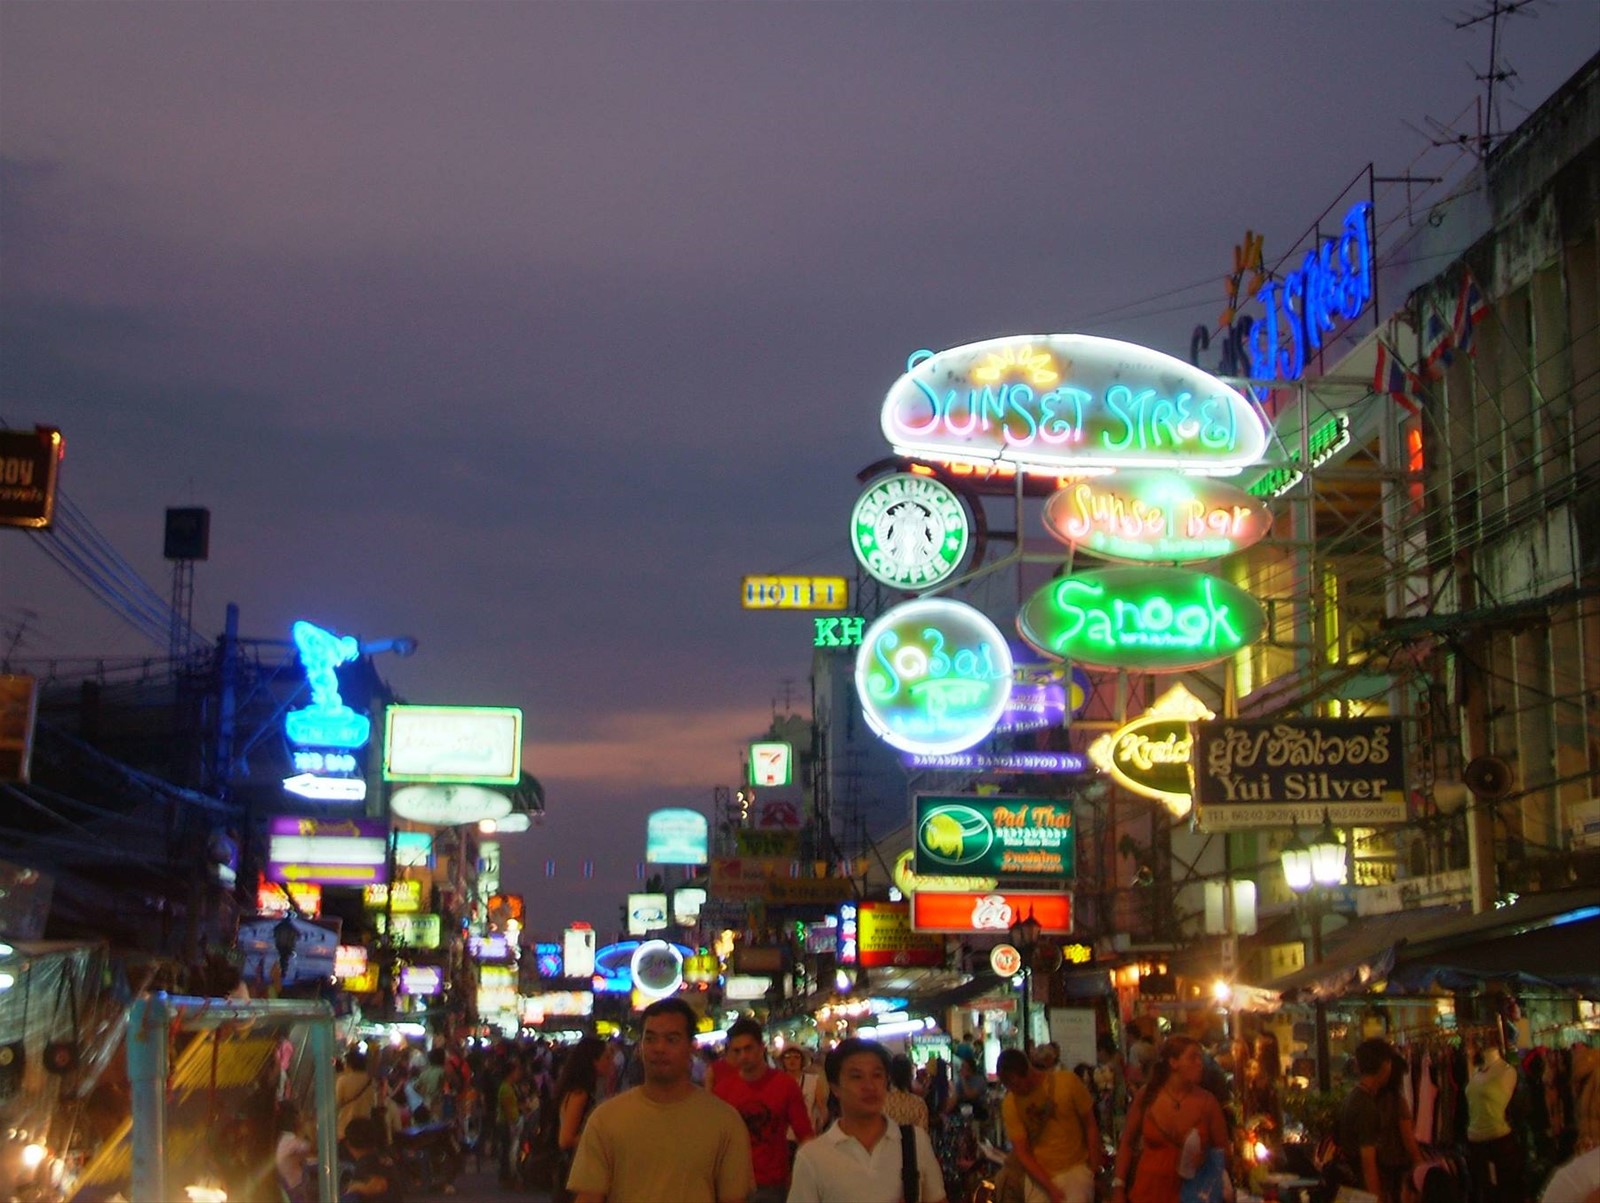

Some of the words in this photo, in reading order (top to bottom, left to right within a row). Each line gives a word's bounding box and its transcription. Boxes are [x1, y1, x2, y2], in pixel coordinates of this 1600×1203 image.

[858, 477, 963, 531] STARBUCKS
[866, 547, 953, 584] COFFEE
[813, 616, 865, 647] KH
[1056, 578, 1241, 650] Sanook
[1219, 773, 1272, 801] Yui
[1285, 773, 1388, 800] Silver
